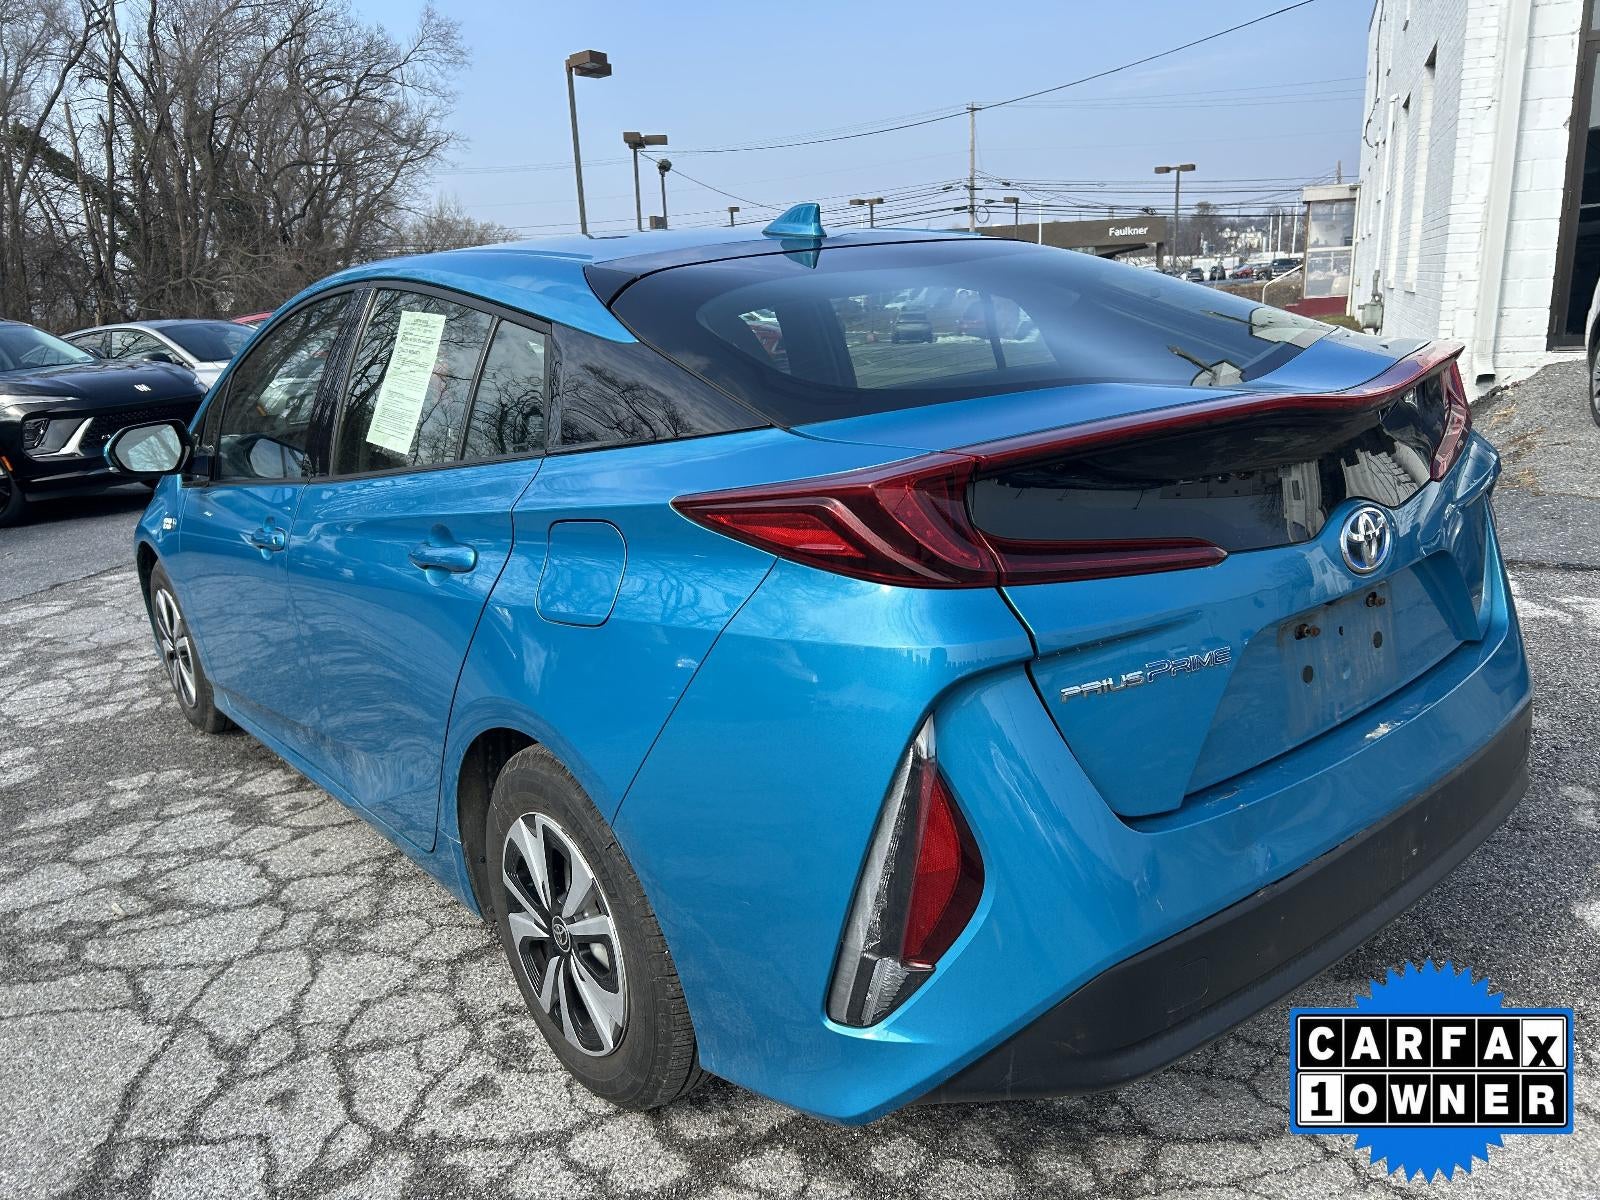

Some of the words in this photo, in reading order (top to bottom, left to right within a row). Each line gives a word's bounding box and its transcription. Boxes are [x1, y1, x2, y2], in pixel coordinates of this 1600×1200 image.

[1108, 226, 1149, 237] Faulkner
[1060, 670, 1145, 704] PRIUS
[1145, 645, 1232, 683] PRIME
